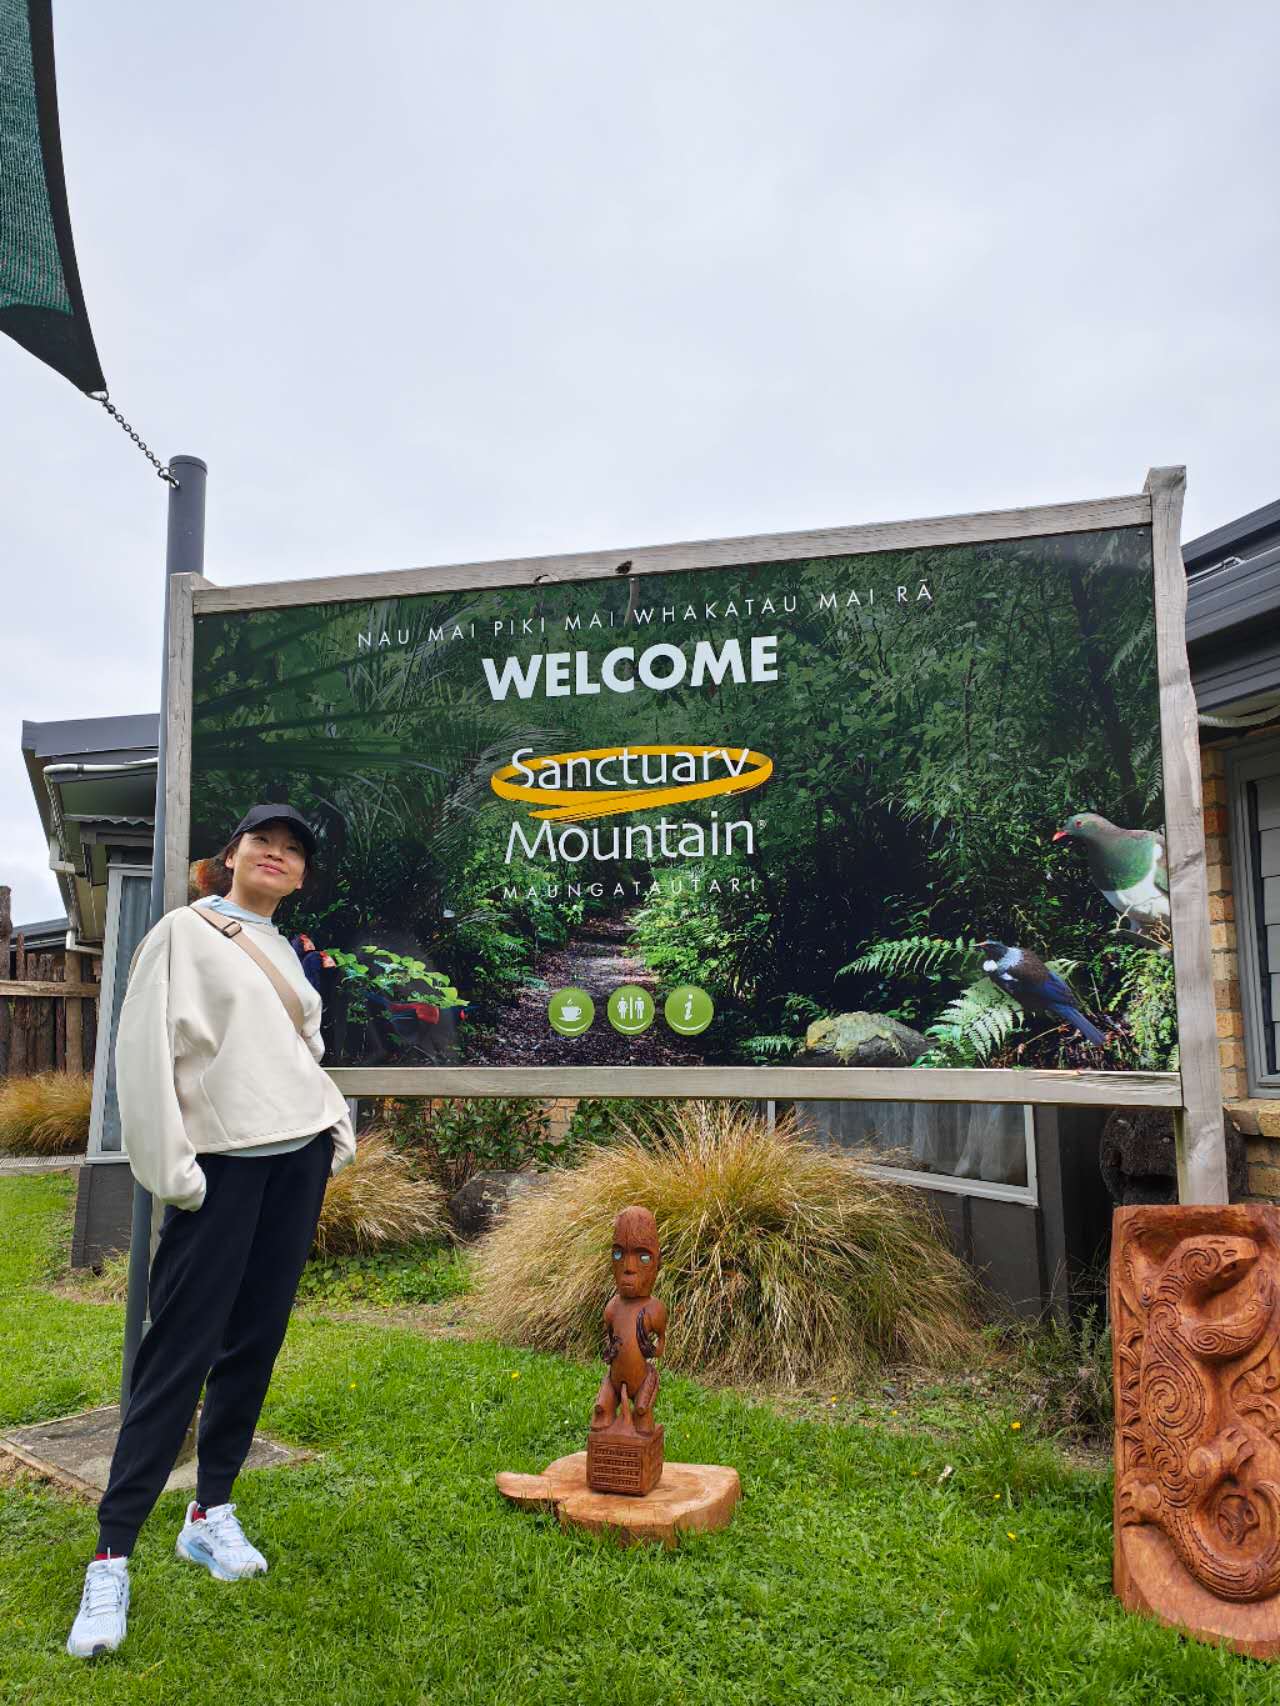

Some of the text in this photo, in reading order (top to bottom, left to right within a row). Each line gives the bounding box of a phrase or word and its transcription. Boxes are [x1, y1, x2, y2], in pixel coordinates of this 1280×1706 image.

[358, 578, 933, 648] NAU MAI PIKI MAI WHAKATAU MAI RĀ
[481, 635, 779, 701] WELCOME
[511, 746, 750, 789] Sanctuary
[504, 810, 755, 864] Mountain
[502, 877, 756, 899] MAUNGATAUTARI
